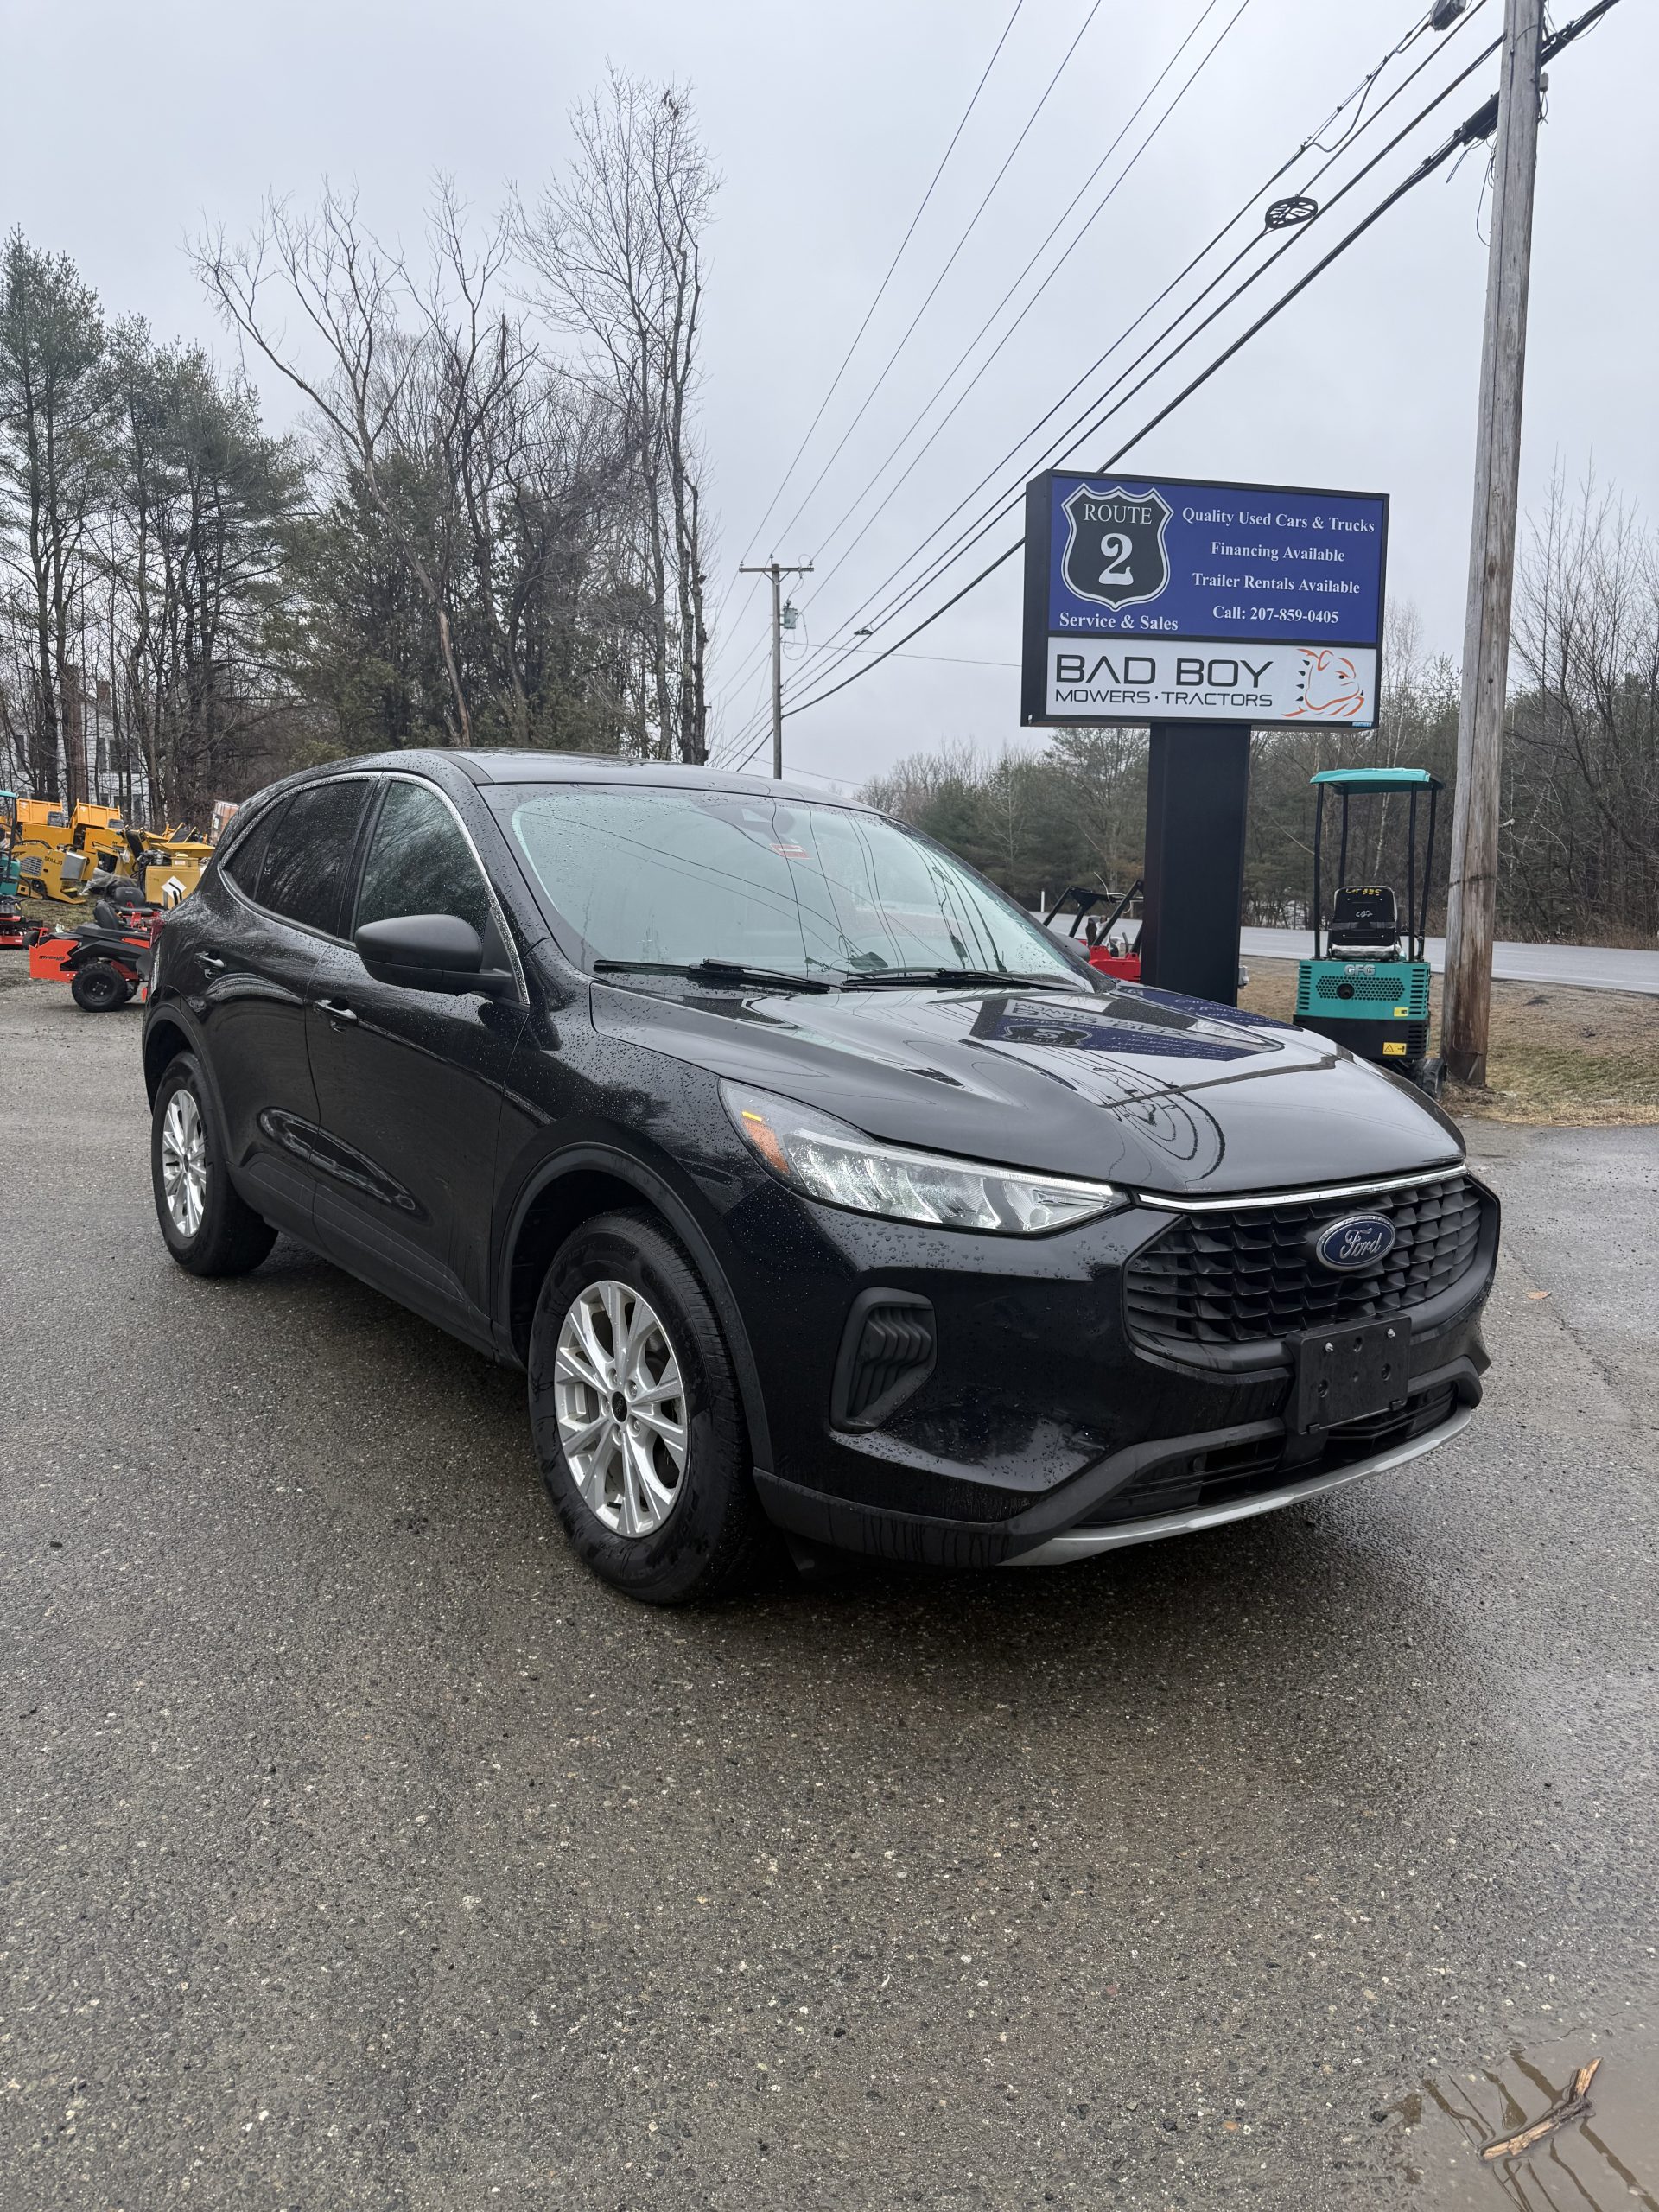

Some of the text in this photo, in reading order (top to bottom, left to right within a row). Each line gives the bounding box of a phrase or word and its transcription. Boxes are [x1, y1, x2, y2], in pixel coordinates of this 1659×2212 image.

[1084, 503, 1153, 524] ROUTE
[1182, 507, 1375, 532] Quality Used Cars & Trucks
[1098, 532, 1134, 586] 2
[1211, 541, 1345, 562] Financing Available
[1192, 572, 1360, 594] Trailer Rentals Available
[1059, 612, 1179, 631] Service & Sales
[1212, 605, 1339, 624] Call: 207-859-0405
[1056, 653, 1274, 689] BAD BOY
[1055, 688, 1273, 707] MOWERS TRACTORS
[1339, 1227, 1383, 1259] Ford
